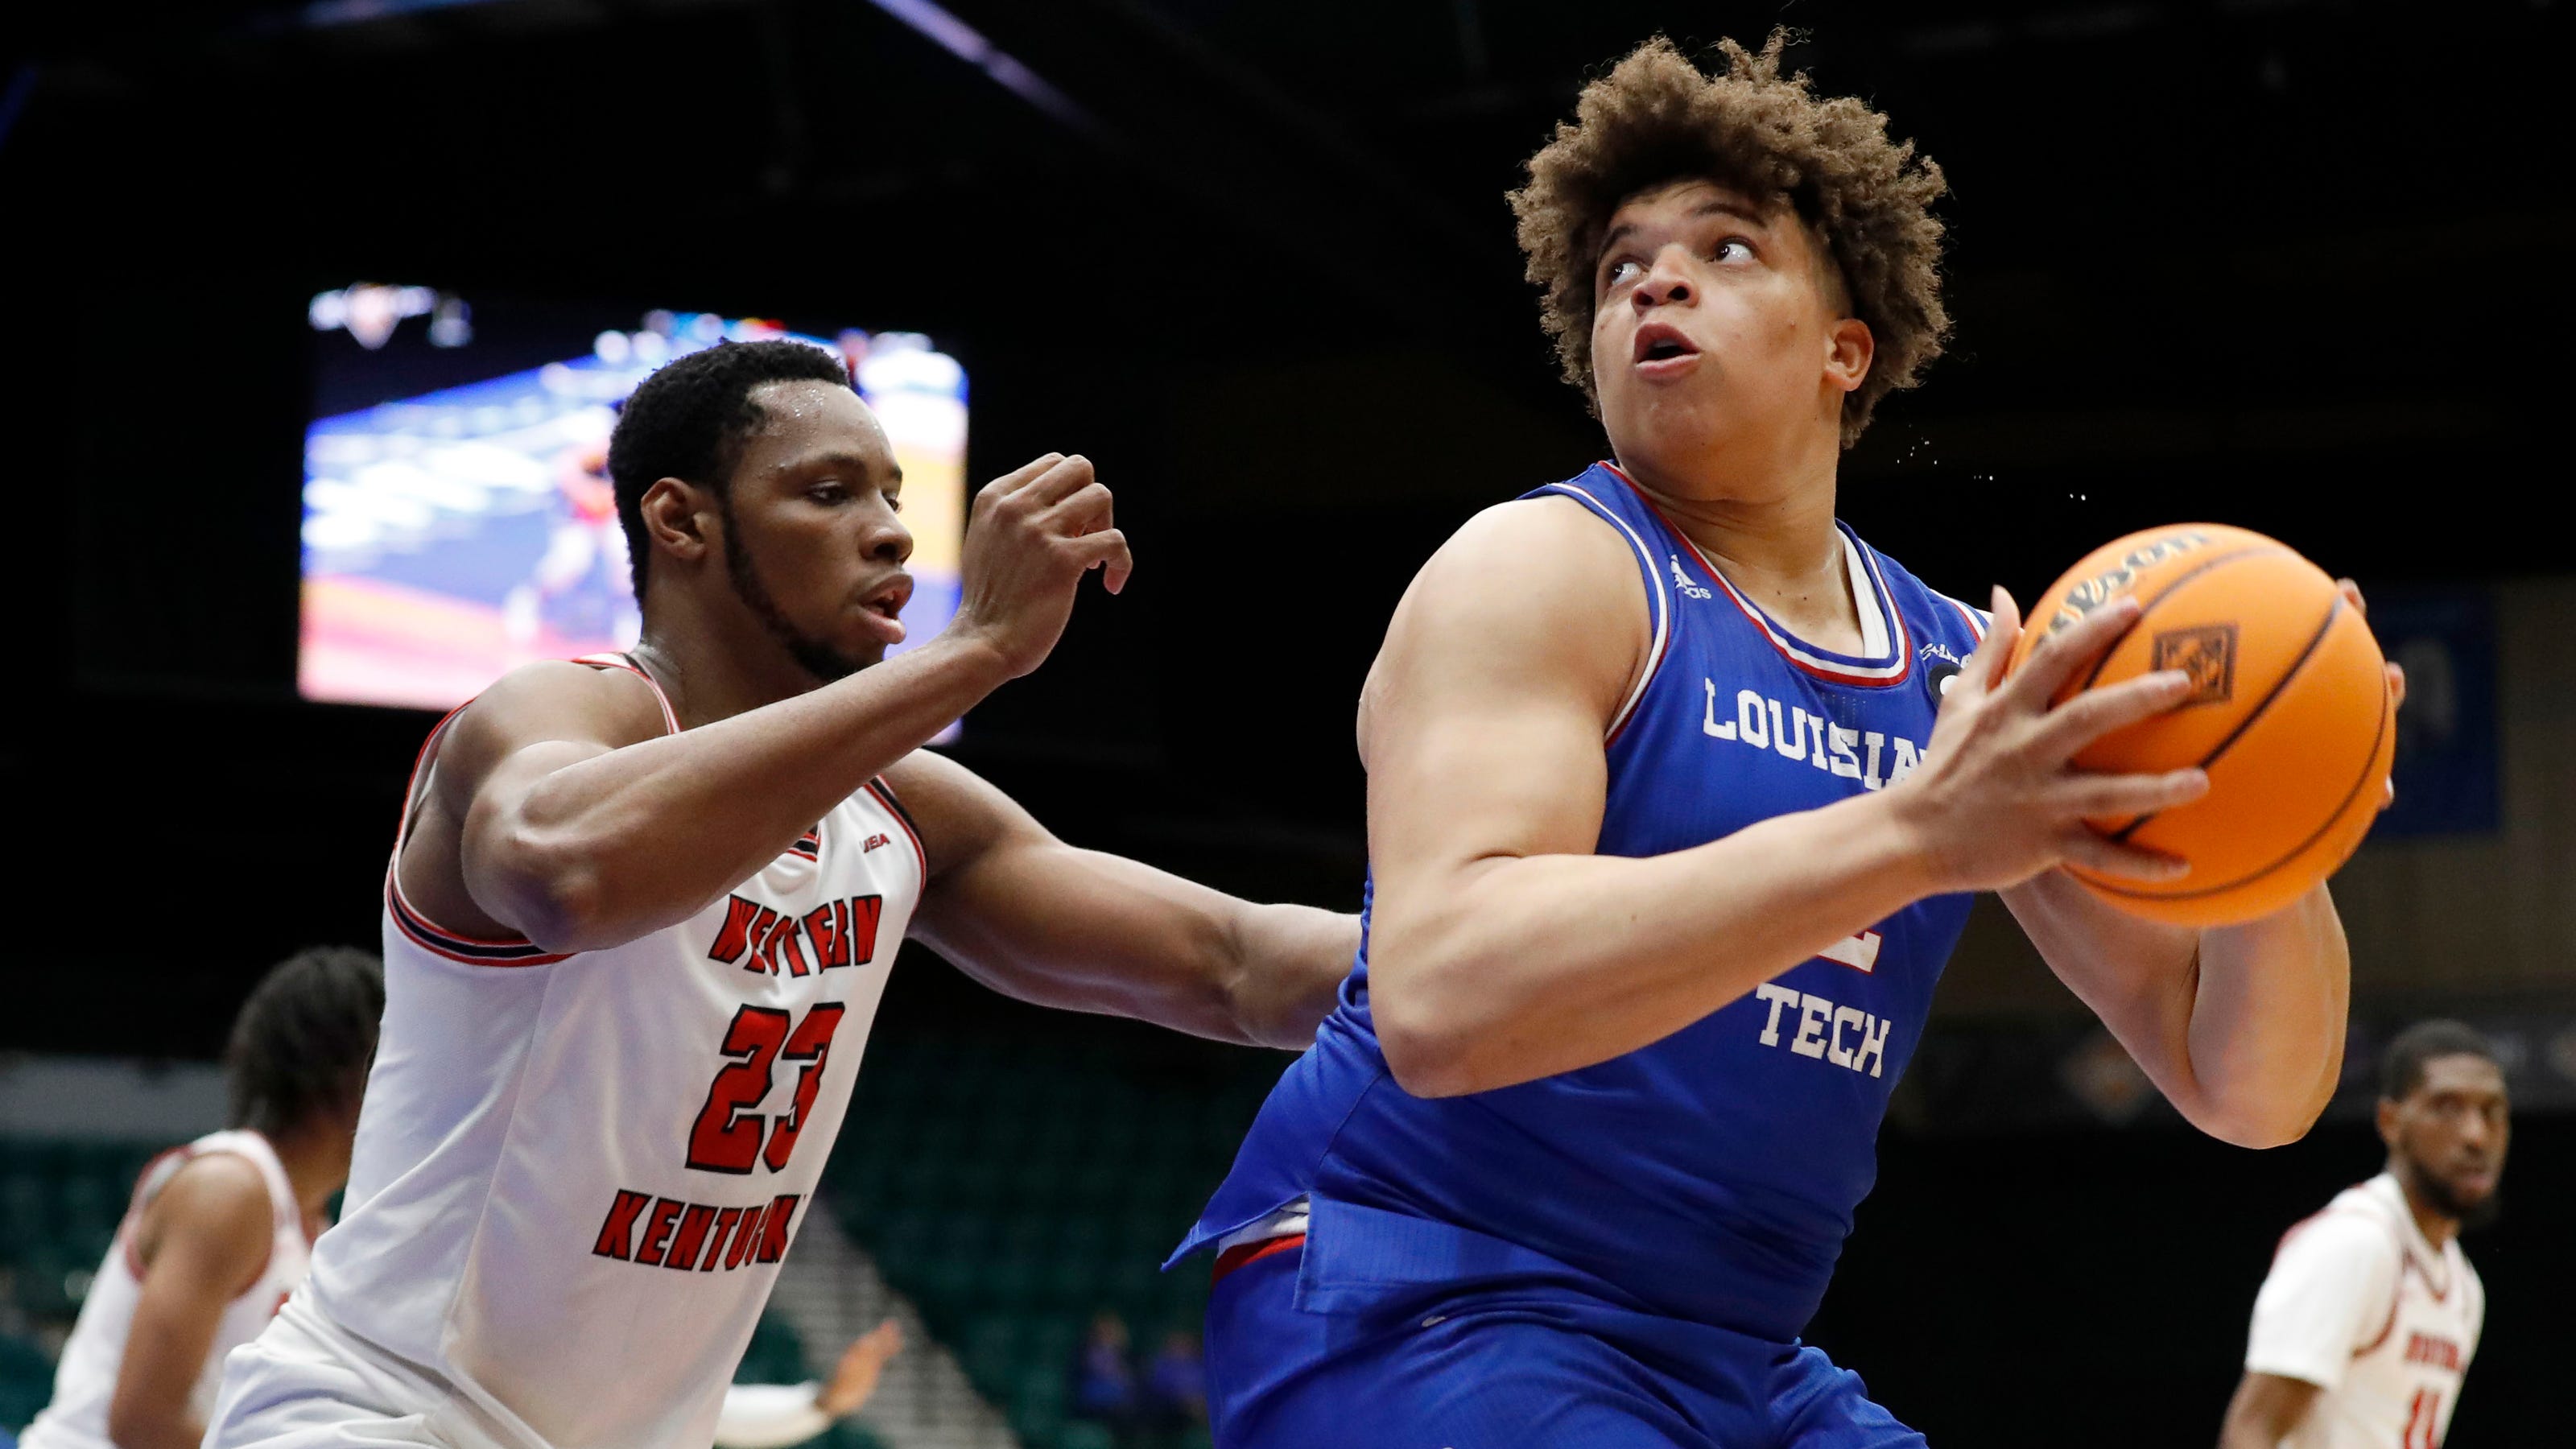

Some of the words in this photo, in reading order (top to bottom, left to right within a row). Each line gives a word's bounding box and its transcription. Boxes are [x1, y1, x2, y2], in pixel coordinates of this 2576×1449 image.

[1703, 677, 1929, 791] LOUISIA
[1756, 981, 1892, 1079] TECH
[685, 1001, 845, 1175] 23
[592, 1188, 807, 1272] KENTUCK
